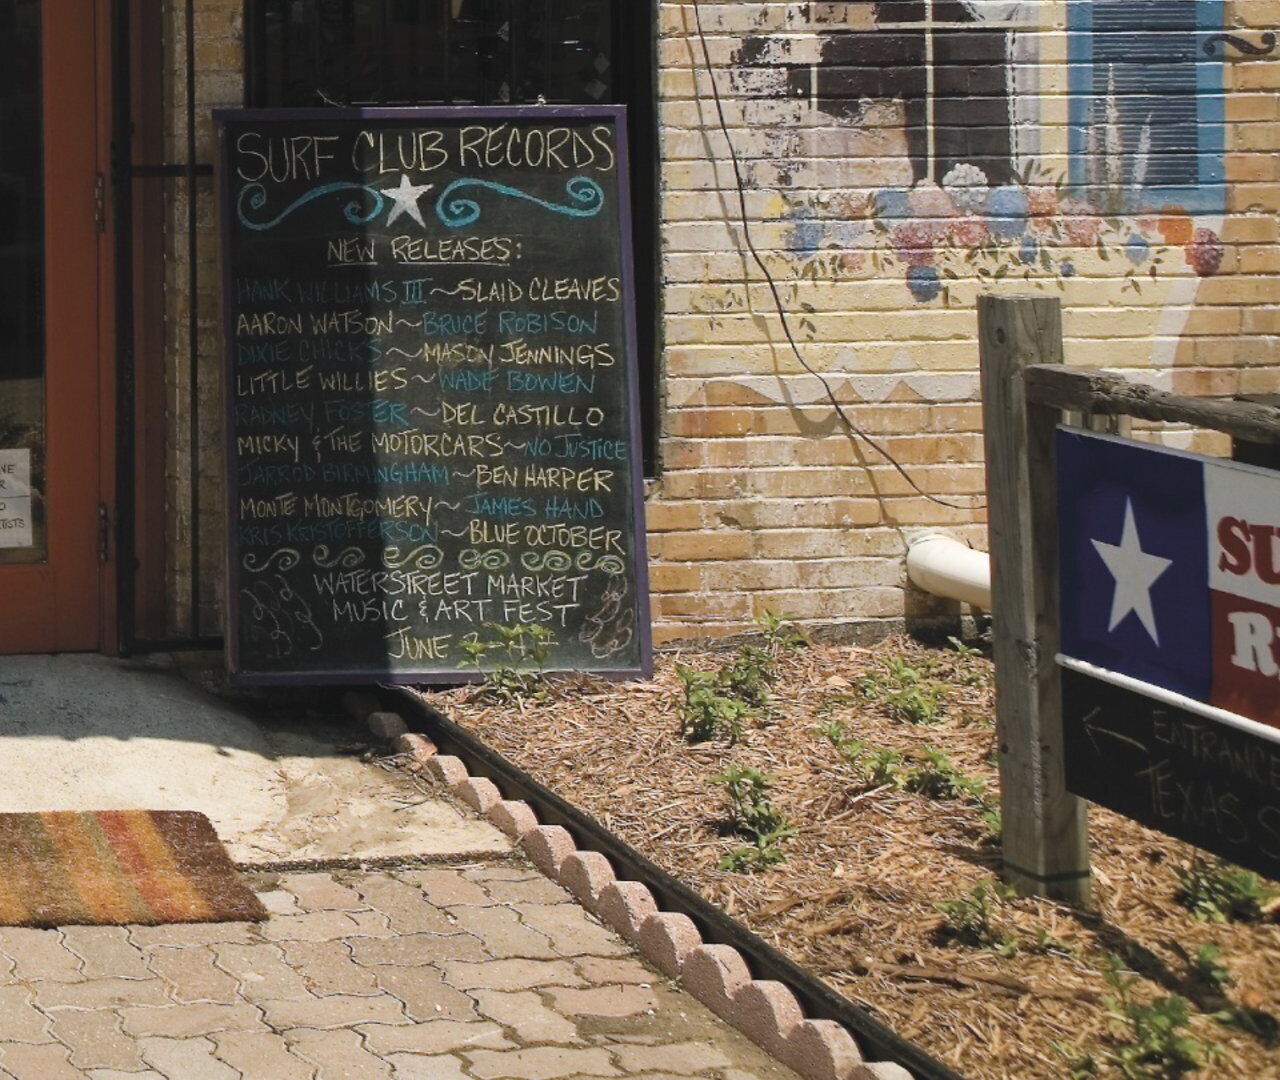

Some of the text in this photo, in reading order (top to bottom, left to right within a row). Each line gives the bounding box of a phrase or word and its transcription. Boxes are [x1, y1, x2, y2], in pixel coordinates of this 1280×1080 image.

[236, 122, 615, 183] SURF CLUB RECORDS
[327, 235, 523, 263] NEW RELEASES:
[238, 277, 292, 304] HANK
[298, 277, 398, 304] WILLIAMS
[456, 277, 523, 303] SLAID
[528, 276, 622, 303] CLEAVES
[236, 309, 598, 336] AARON WATSON BRUCE ROBISON
[238, 338, 616, 367] DIXIE CHICKS MASON JENNINGS
[237, 366, 596, 397] LITTLE WILLIES WADE BOWEN
[236, 399, 604, 428] RADNEY FOSTER DEL CASTILLO
[236, 434, 300, 468] MICKY
[325, 426, 362, 454] THE
[371, 427, 504, 457] MOTORCARS
[523, 437, 552, 459] NO
[238, 460, 614, 493] JARROD BIRMINGHAM BEN HARPER
[240, 492, 604, 526] MONTE MONTGOMERY JAMES HAND
[240, 519, 626, 553] KRIS KRISTOFFERSON BLUE OCTOBER
[487, 571, 590, 602] MARKET
[331, 598, 410, 622] MUSIC
[434, 599, 497, 622] ART
[503, 598, 582, 627] FEST
[382, 625, 454, 661] JUNE
[1228, 610, 1280, 678] R
[1151, 709, 1280, 791] ENTRANCE
[1136, 758, 1249, 846] TEXAS
